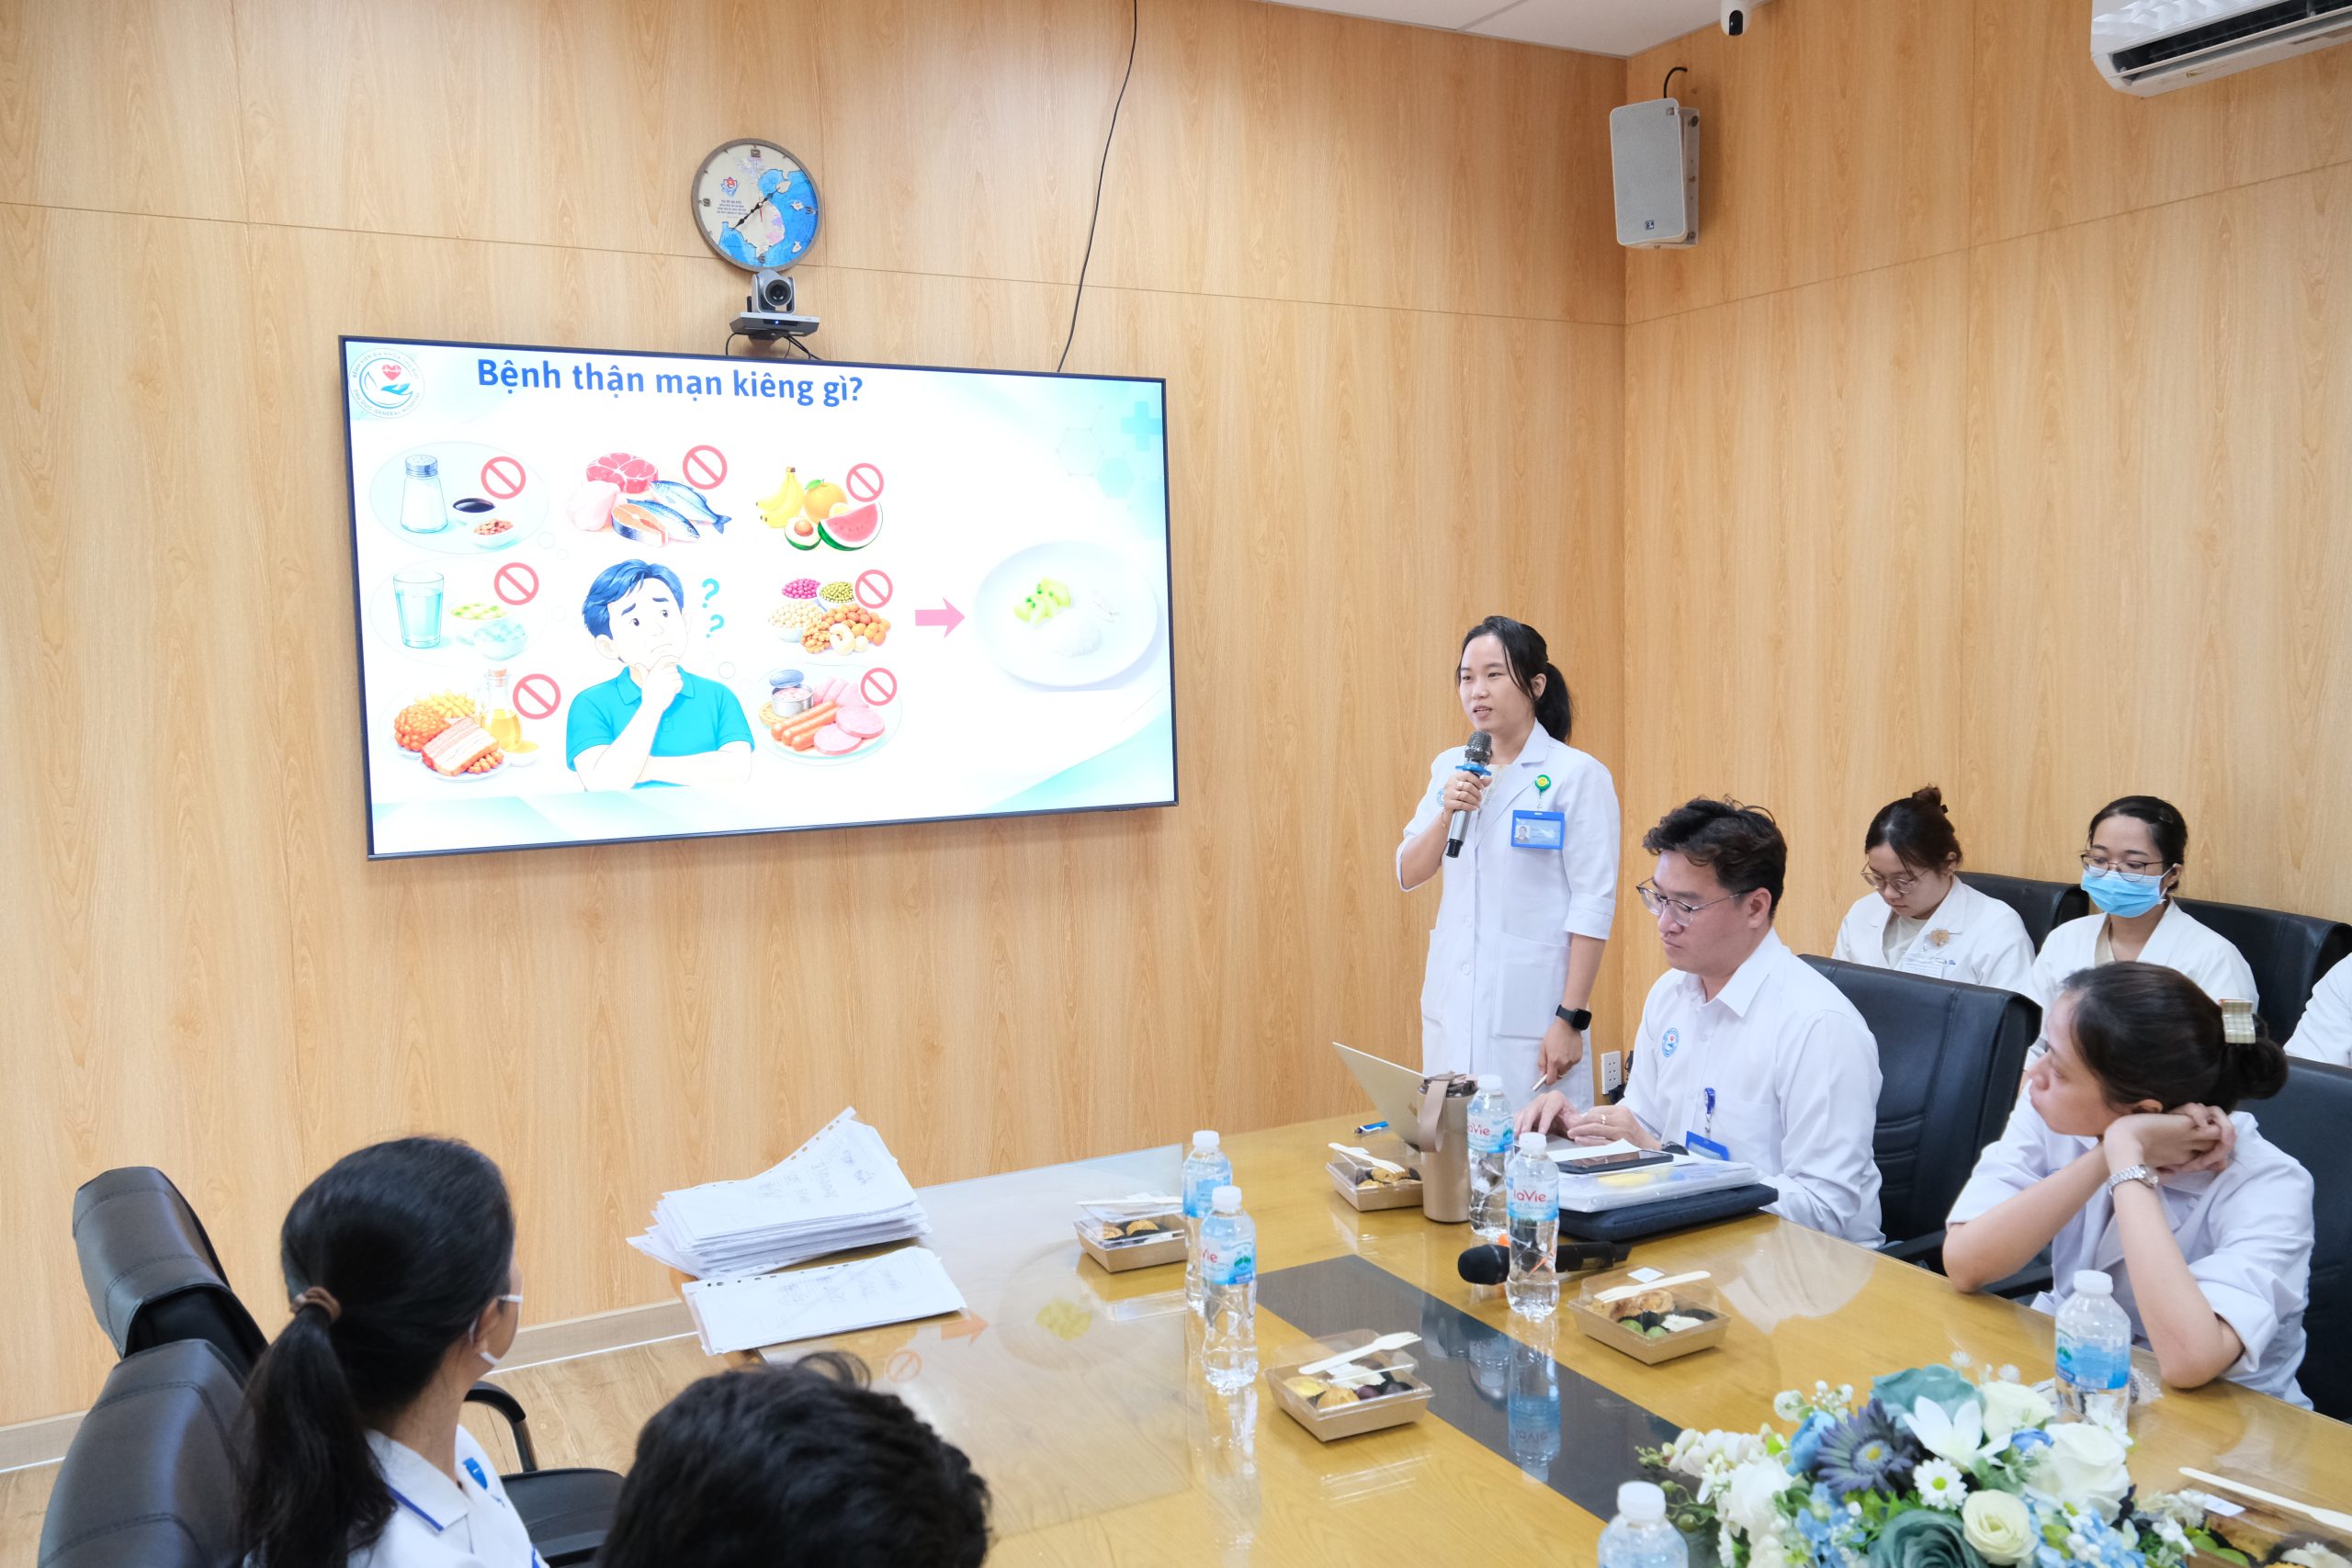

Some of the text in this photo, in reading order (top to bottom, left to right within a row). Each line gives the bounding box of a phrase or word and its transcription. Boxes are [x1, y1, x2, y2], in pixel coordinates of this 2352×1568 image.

[477, 358, 864, 408] Bệnh thận mạn kiêng gì?
